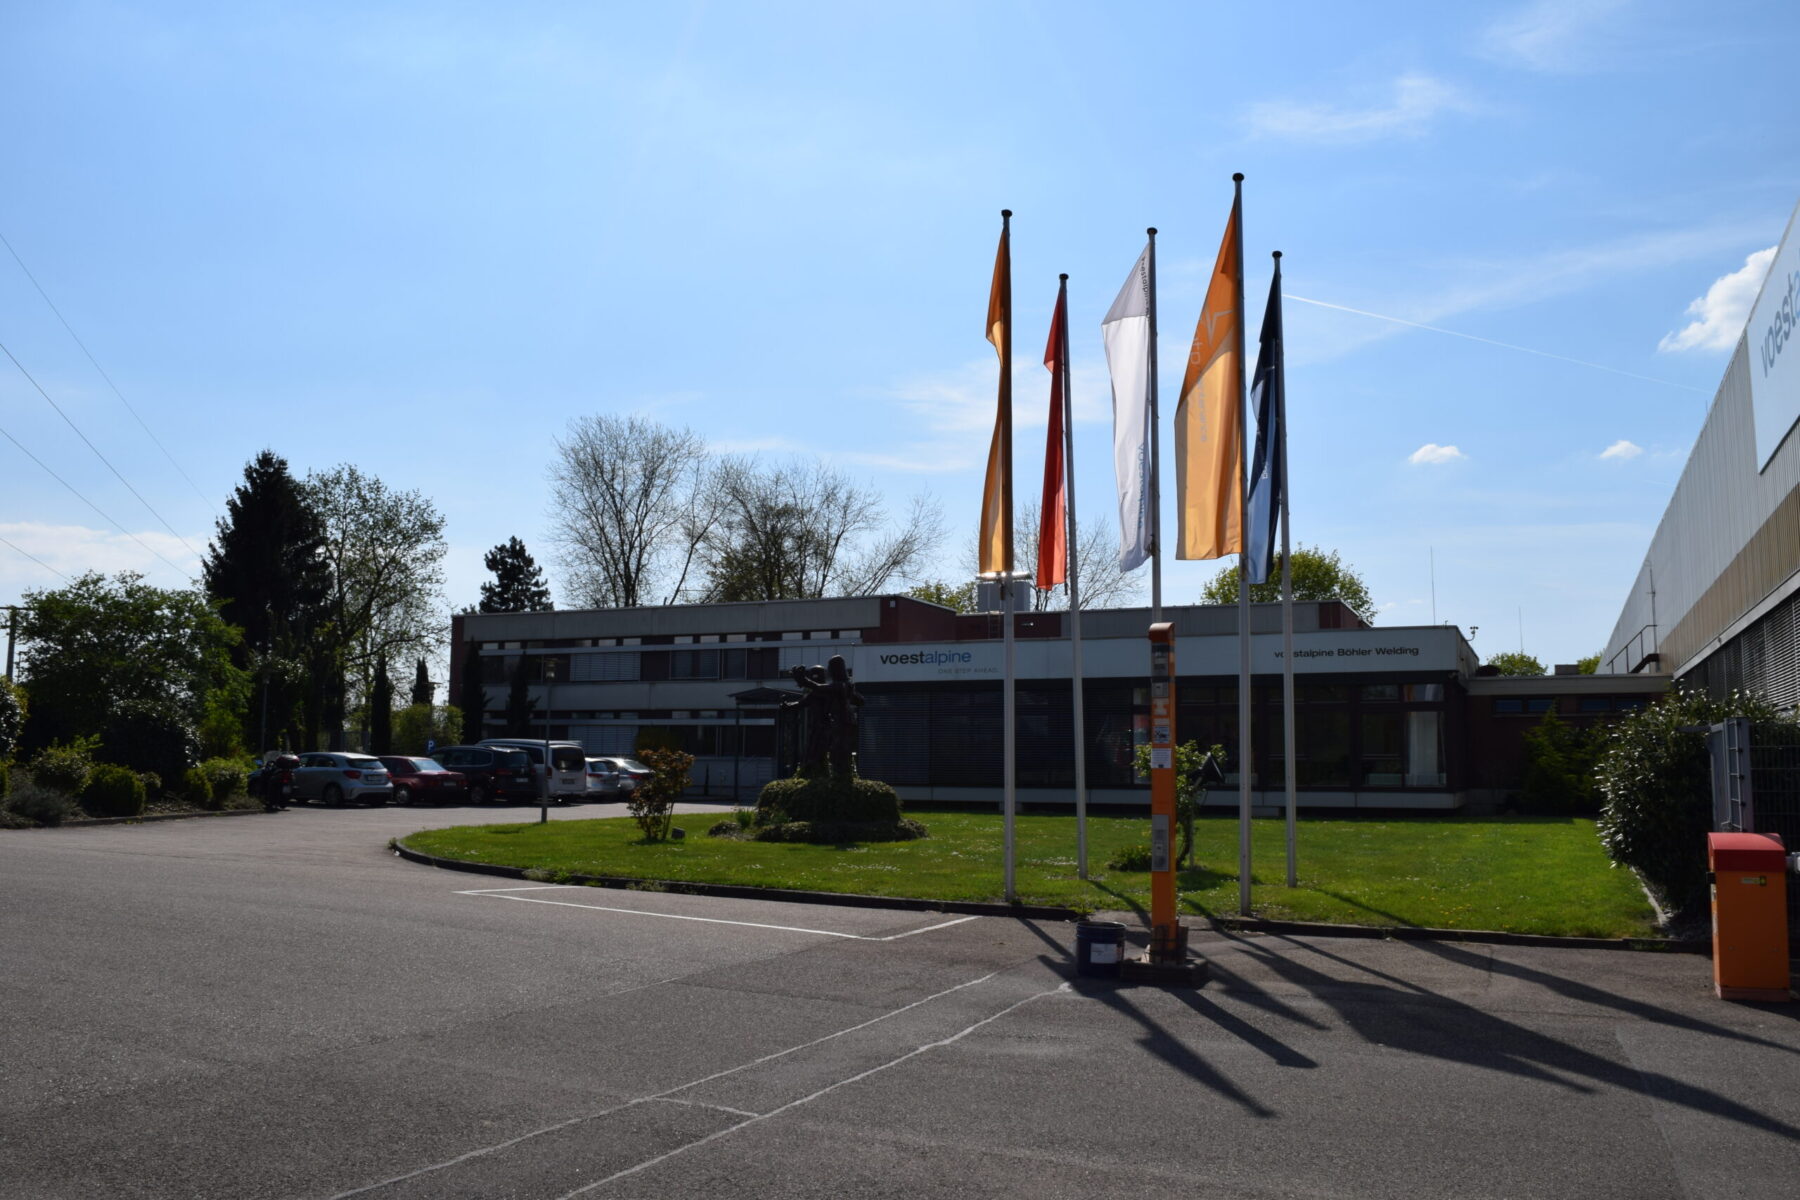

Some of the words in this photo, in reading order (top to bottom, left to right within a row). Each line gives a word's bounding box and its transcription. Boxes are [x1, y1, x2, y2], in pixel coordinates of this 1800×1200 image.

[1760, 247, 1800, 378] voesta
[880, 650, 972, 666] voestalpine
[1274, 648, 1334, 658] vstalpine
[1337, 647, 1372, 657] Böhler
[1375, 646, 1419, 657] Welding
